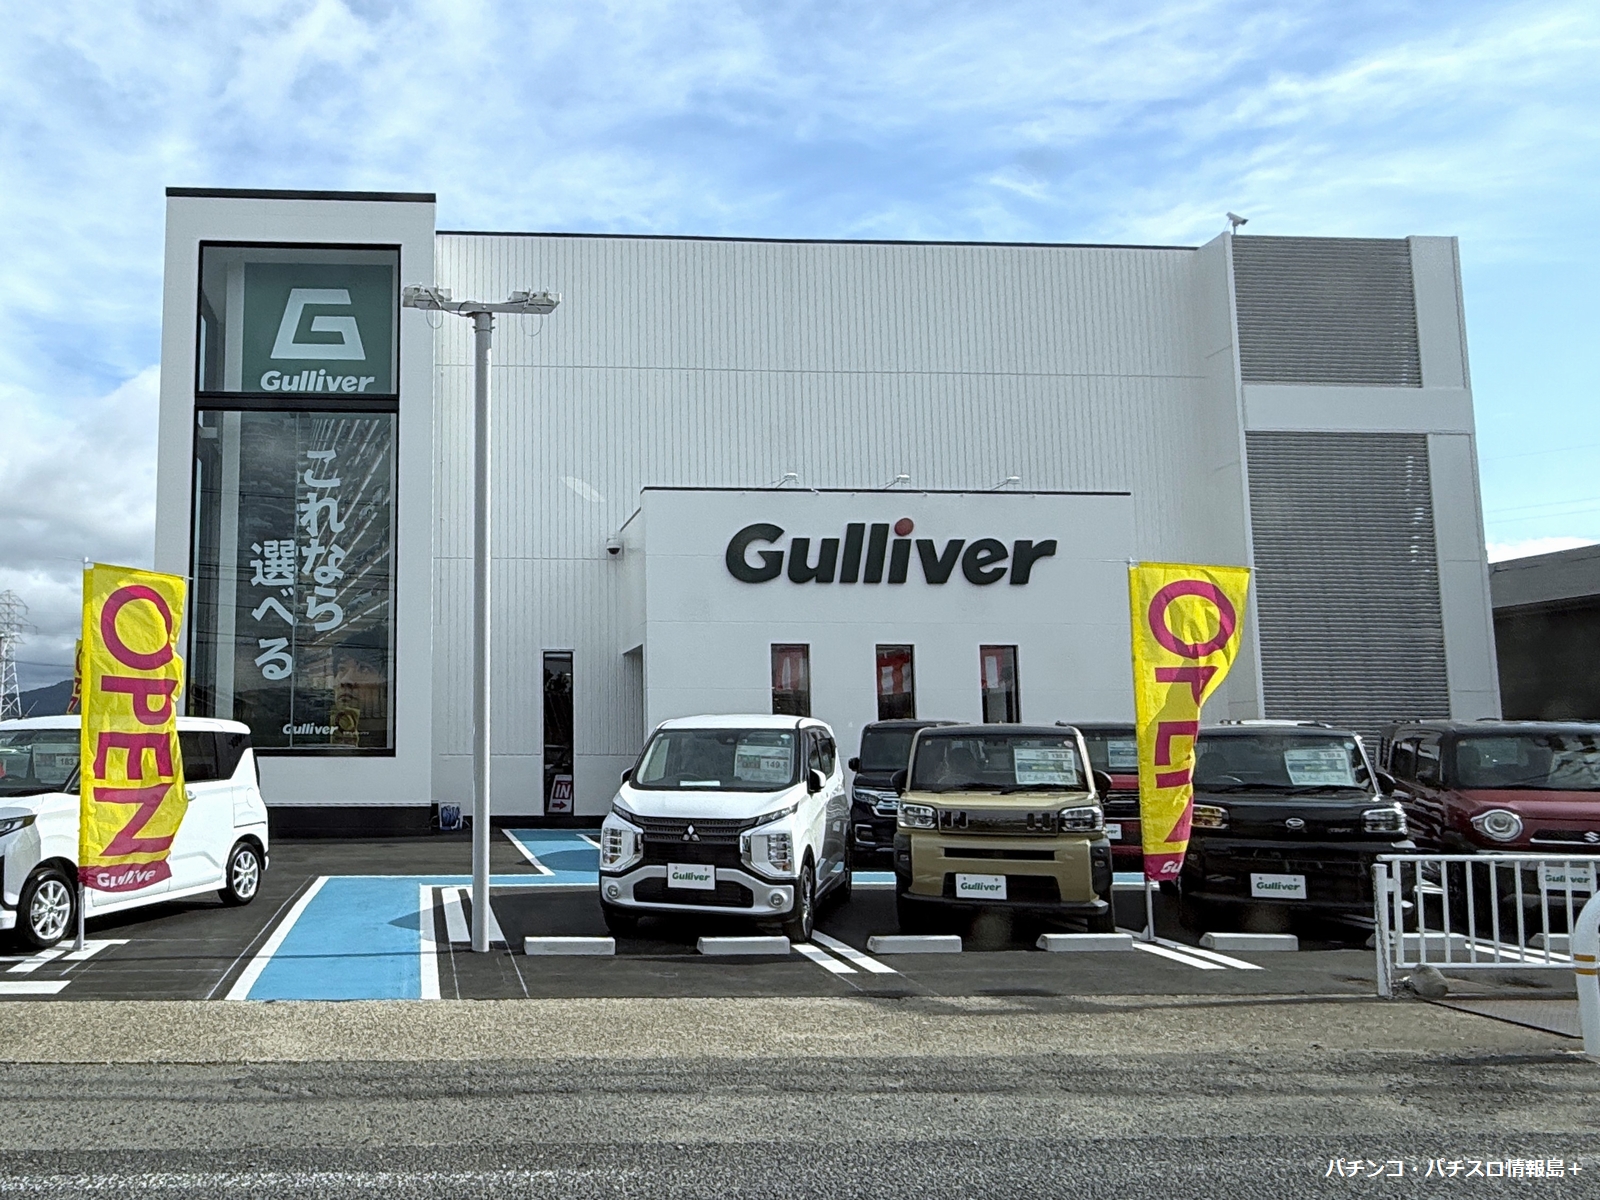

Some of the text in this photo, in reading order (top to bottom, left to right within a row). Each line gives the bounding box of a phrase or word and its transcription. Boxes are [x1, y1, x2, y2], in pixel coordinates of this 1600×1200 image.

[270, 288, 366, 360] G
[260, 368, 375, 392] Gulliver
[299, 449, 346, 632] これなら
[725, 517, 1058, 585] Gulliver
[250, 539, 299, 680] 選べる
[93, 584, 179, 857] OPEN
[282, 722, 339, 735] Gulliver
[60, 757, 77, 767] 183.
[555, 784, 572, 799] IN
[96, 869, 157, 888] Gullive
[671, 871, 711, 883] Gulliver
[1255, 879, 1301, 892] Gulliver
[1545, 874, 1591, 883] Gullver
[960, 882, 1002, 891] Gulliver
